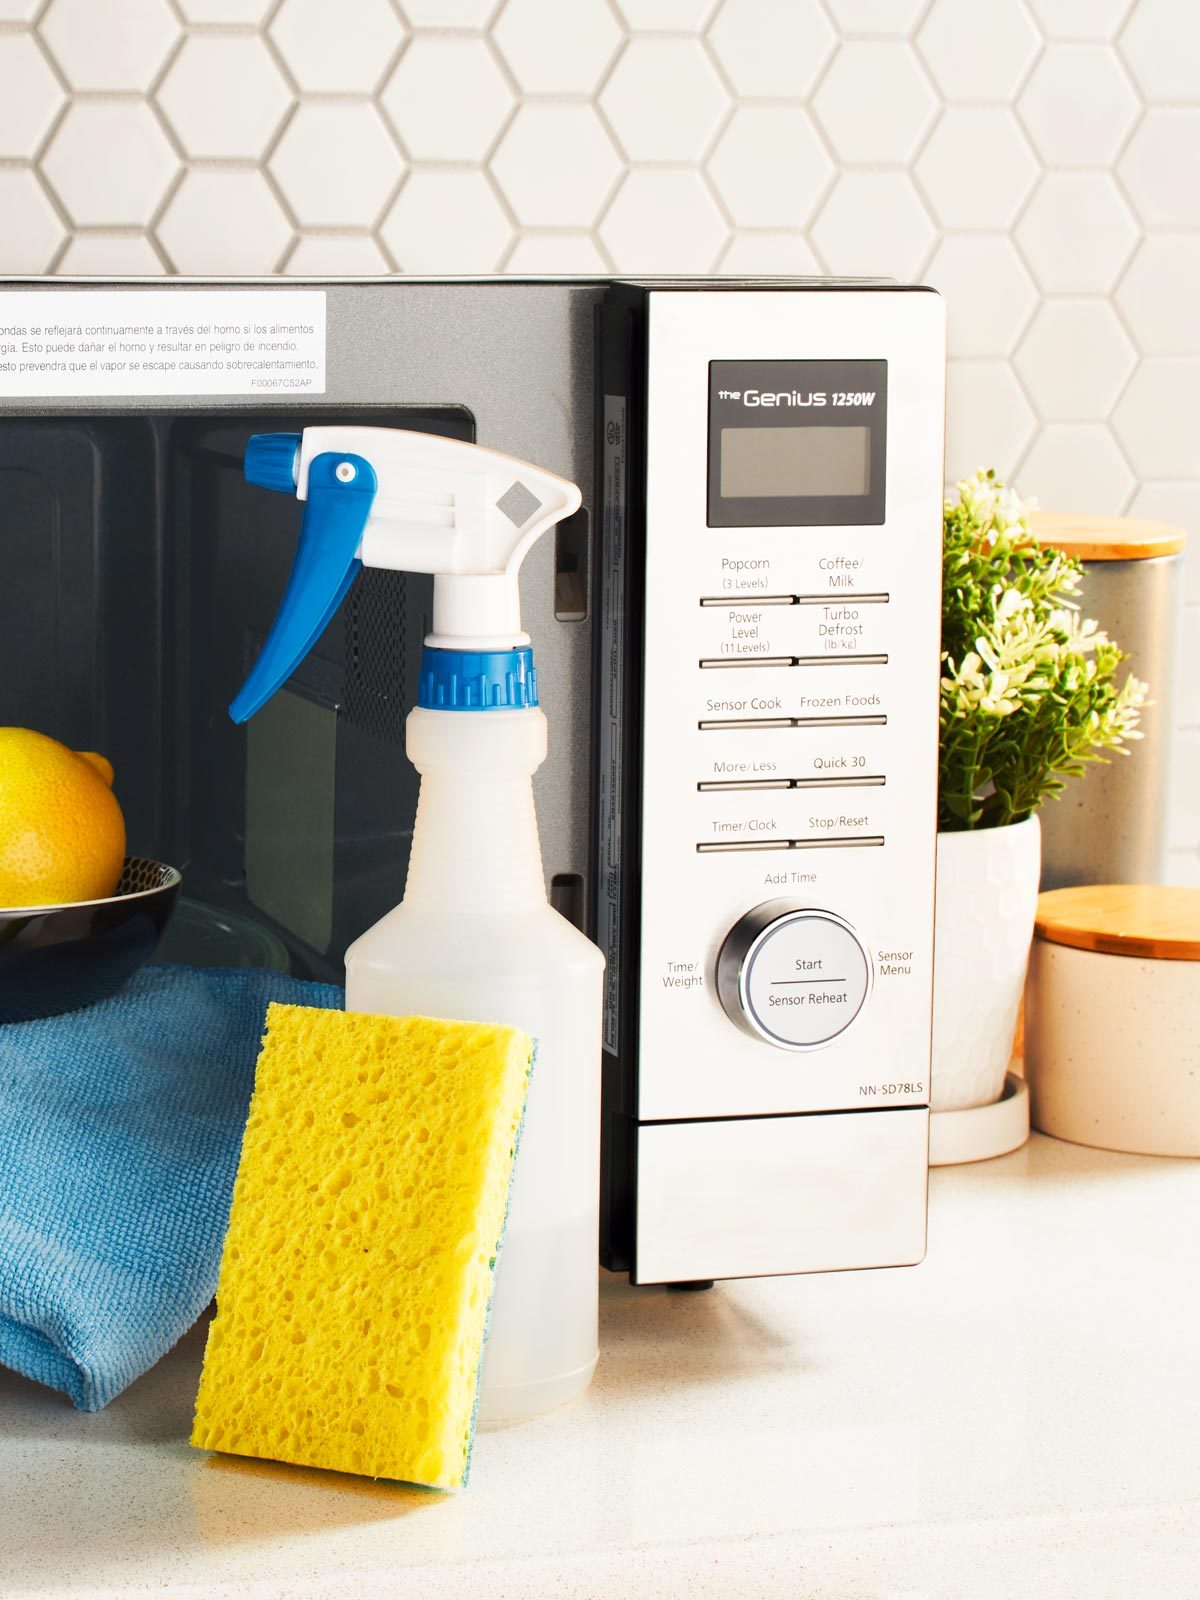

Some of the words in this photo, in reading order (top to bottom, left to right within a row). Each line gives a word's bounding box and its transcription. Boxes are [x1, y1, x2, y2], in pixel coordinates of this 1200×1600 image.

[718, 390, 741, 400] the
[743, 390, 827, 407] Genius
[832, 392, 876, 406] 1250W
[721, 558, 770, 572] Popcorn
[818, 557, 864, 570] Coffee/
[722, 578, 732, 589] (3
[735, 577, 769, 589] Levels)
[829, 575, 854, 587] Milk
[729, 611, 762, 623] Power
[823, 605, 859, 620] Turbo
[732, 626, 759, 639] Level
[818, 623, 863, 636] Defrost
[720, 642, 735, 654] (11
[737, 641, 770, 653] Levels)
[706, 699, 748, 712] Sensor
[750, 697, 782, 710] Cook
[800, 696, 841, 708] Frozen
[845, 694, 881, 707] Foods
[813, 756, 847, 770] Quick
[851, 756, 866, 768] 30
[712, 818, 777, 832] Timer/Clock
[808, 815, 869, 829] Stop/Reset
[764, 872, 788, 885] Add
[790, 872, 817, 884] Time
[878, 950, 914, 962] Sensor
[667, 961, 699, 973] Time/
[795, 959, 823, 971] Start
[880, 964, 911, 976] Menu
[663, 975, 704, 989] Weight
[768, 995, 805, 1007] Sensor
[808, 992, 848, 1005] Reheat
[859, 1082, 923, 1096] NN-SD78LS
